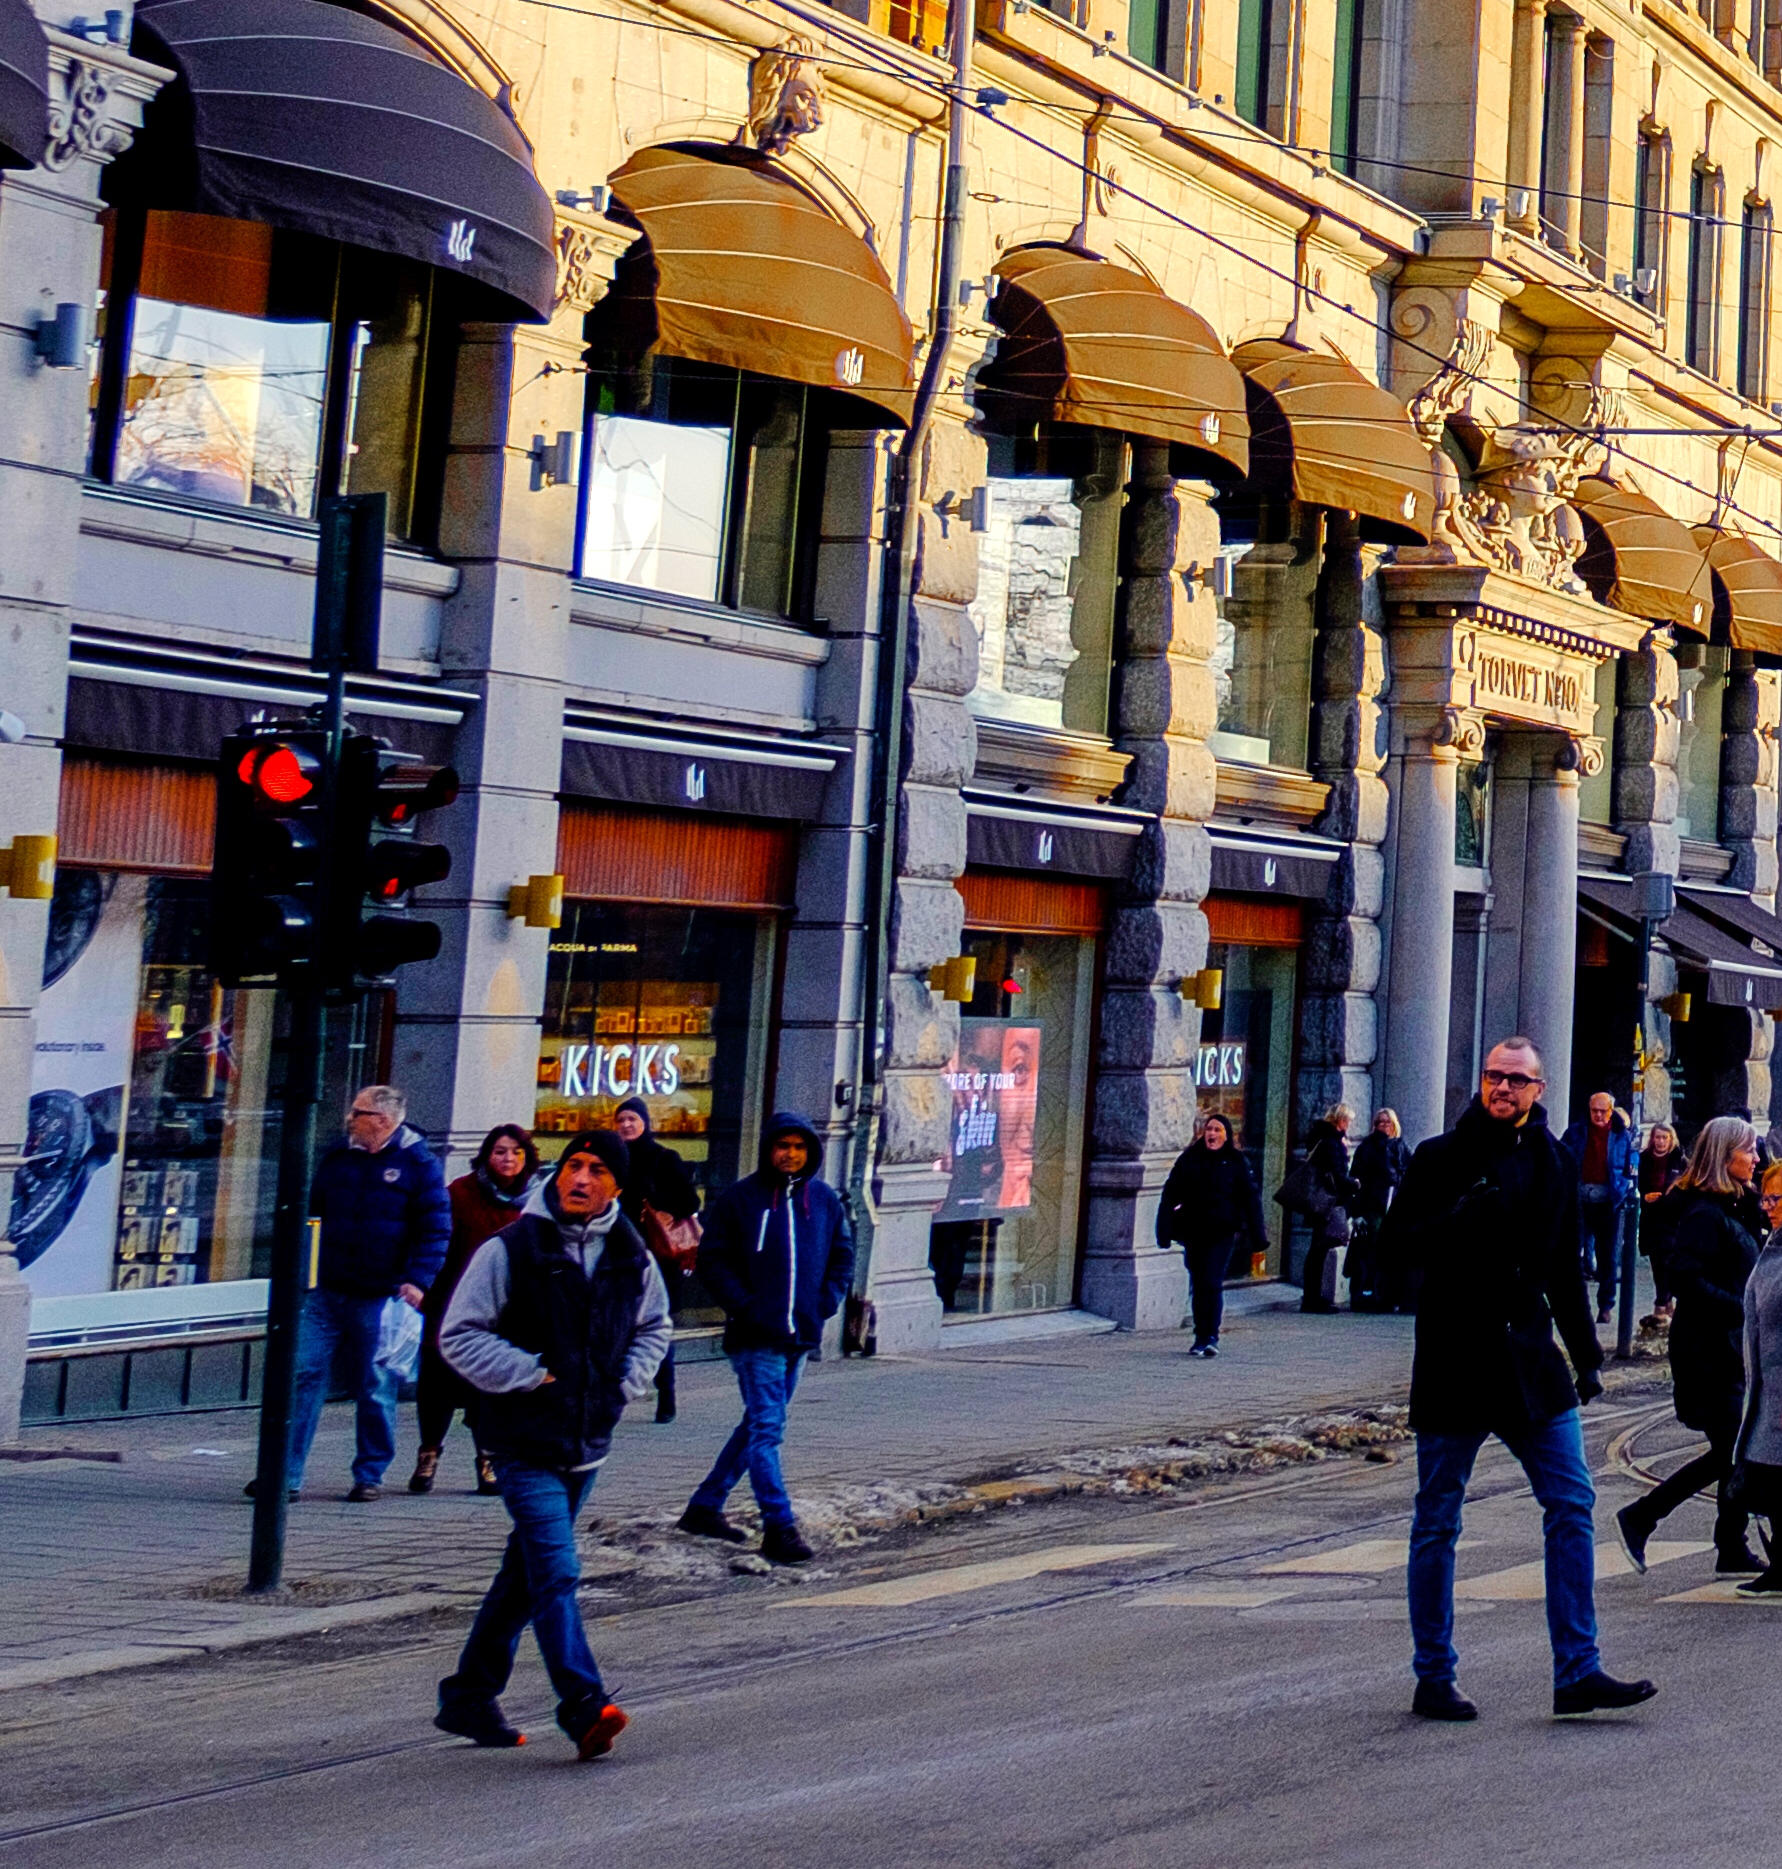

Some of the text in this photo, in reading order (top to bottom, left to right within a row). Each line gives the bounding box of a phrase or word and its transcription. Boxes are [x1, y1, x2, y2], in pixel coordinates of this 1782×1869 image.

[1478, 651, 1542, 704] TORVET
[563, 1044, 680, 1097] KICKS
[1195, 1046, 1243, 1086] ICKS
